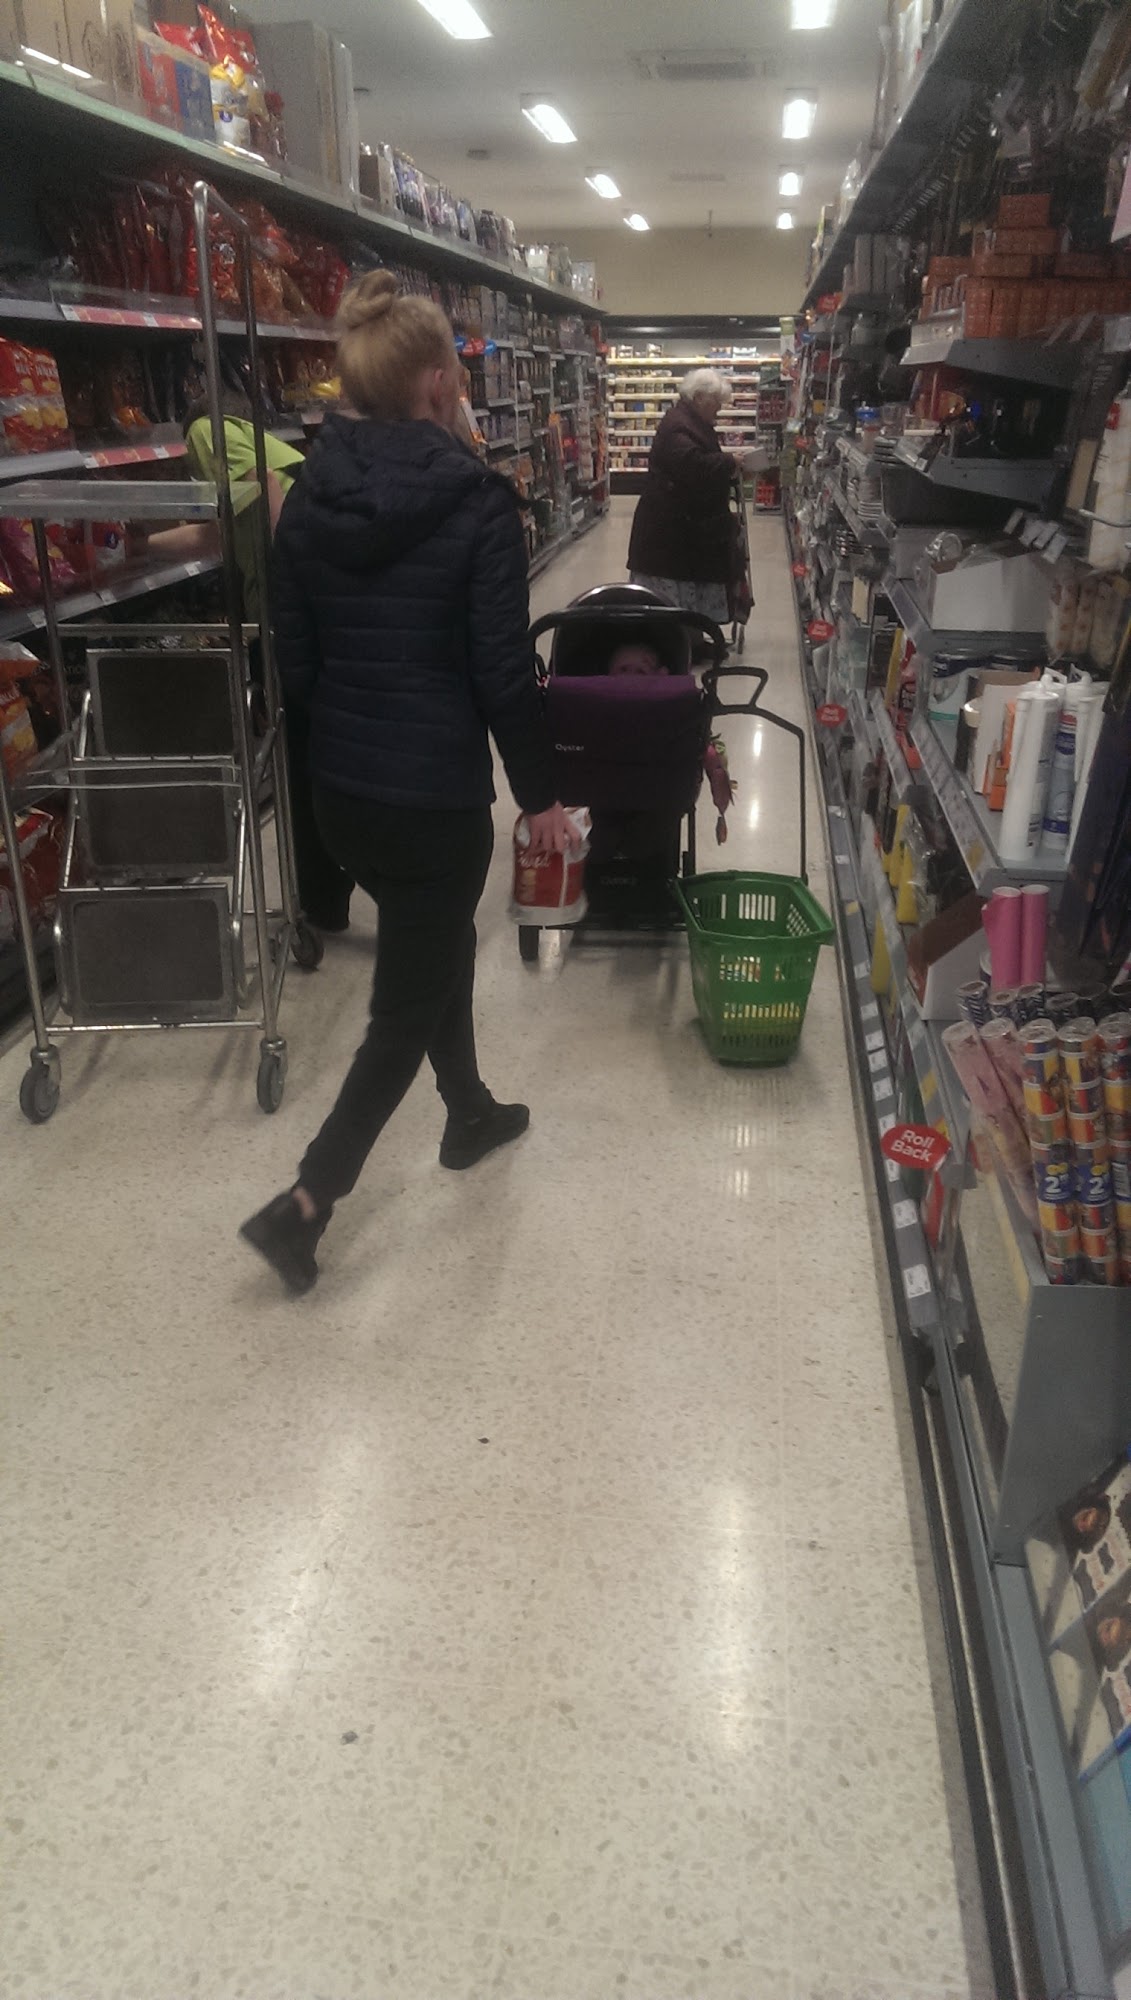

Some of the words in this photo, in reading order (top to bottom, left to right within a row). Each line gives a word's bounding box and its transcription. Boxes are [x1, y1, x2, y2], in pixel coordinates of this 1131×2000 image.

[555, 743, 585, 752] Oyster
[901, 1129, 936, 1149] Roll
[890, 1139, 933, 1162] Back
